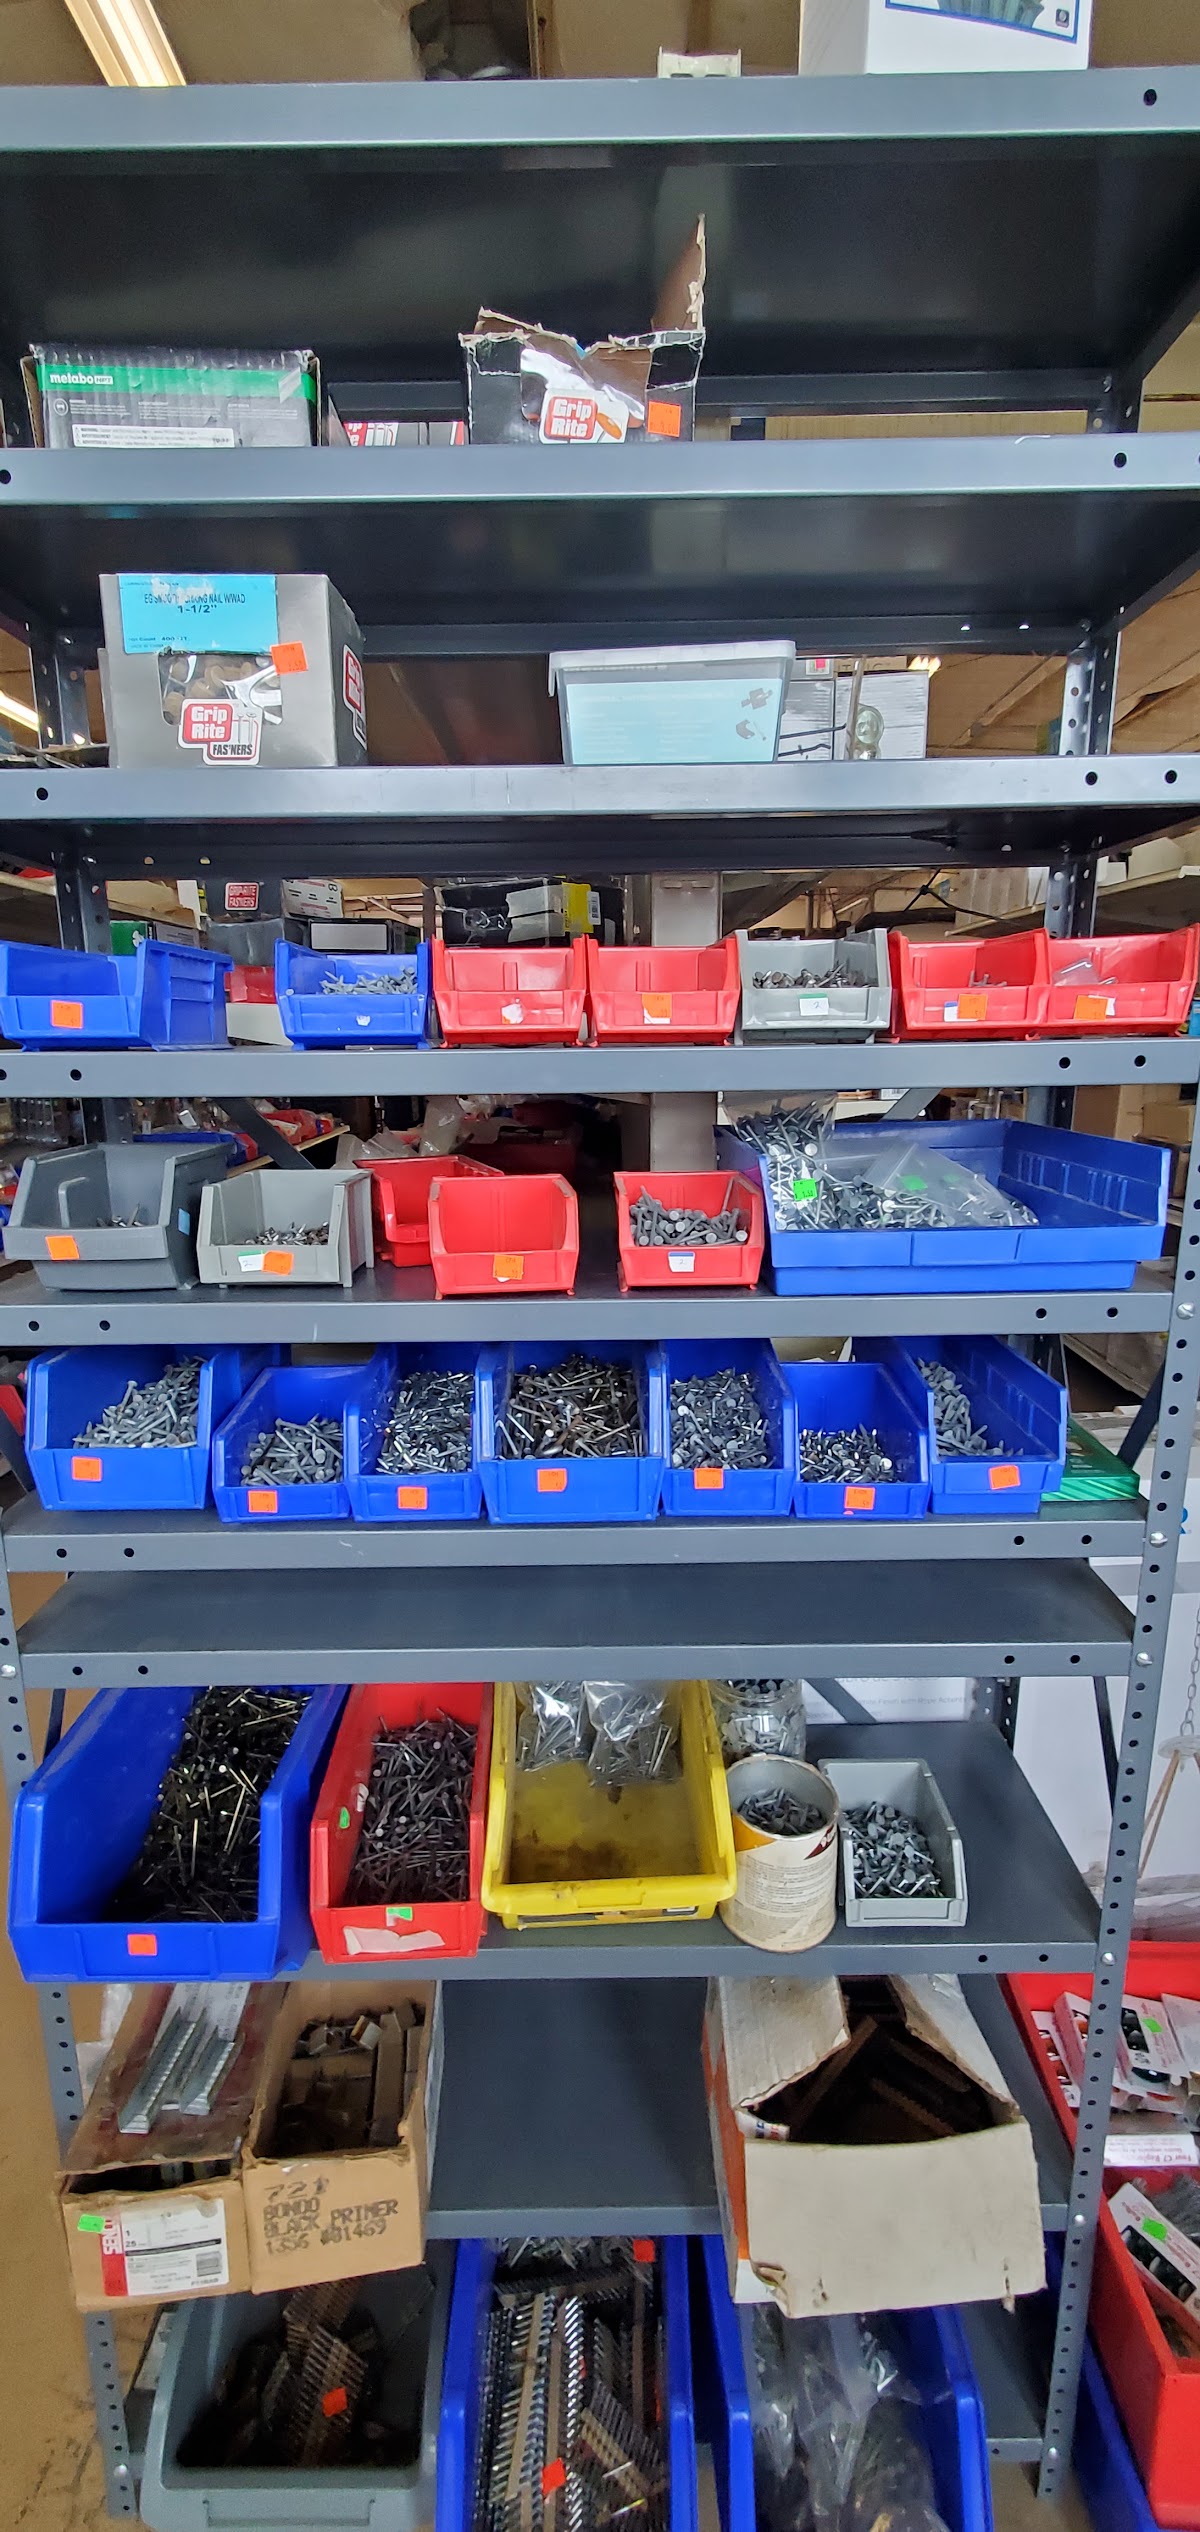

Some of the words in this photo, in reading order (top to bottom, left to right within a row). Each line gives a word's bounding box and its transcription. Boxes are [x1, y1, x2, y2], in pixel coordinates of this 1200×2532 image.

[50, 372, 94, 385] metabo
[553, 399, 593, 422] Grip
[550, 418, 589, 438] Rite
[191, 706, 228, 724] Grip
[191, 723, 227, 740] Rite
[212, 744, 253, 756] FAS'NERS
[263, 2197, 321, 2222] BONDO
[330, 2199, 399, 2226] PRIMER
